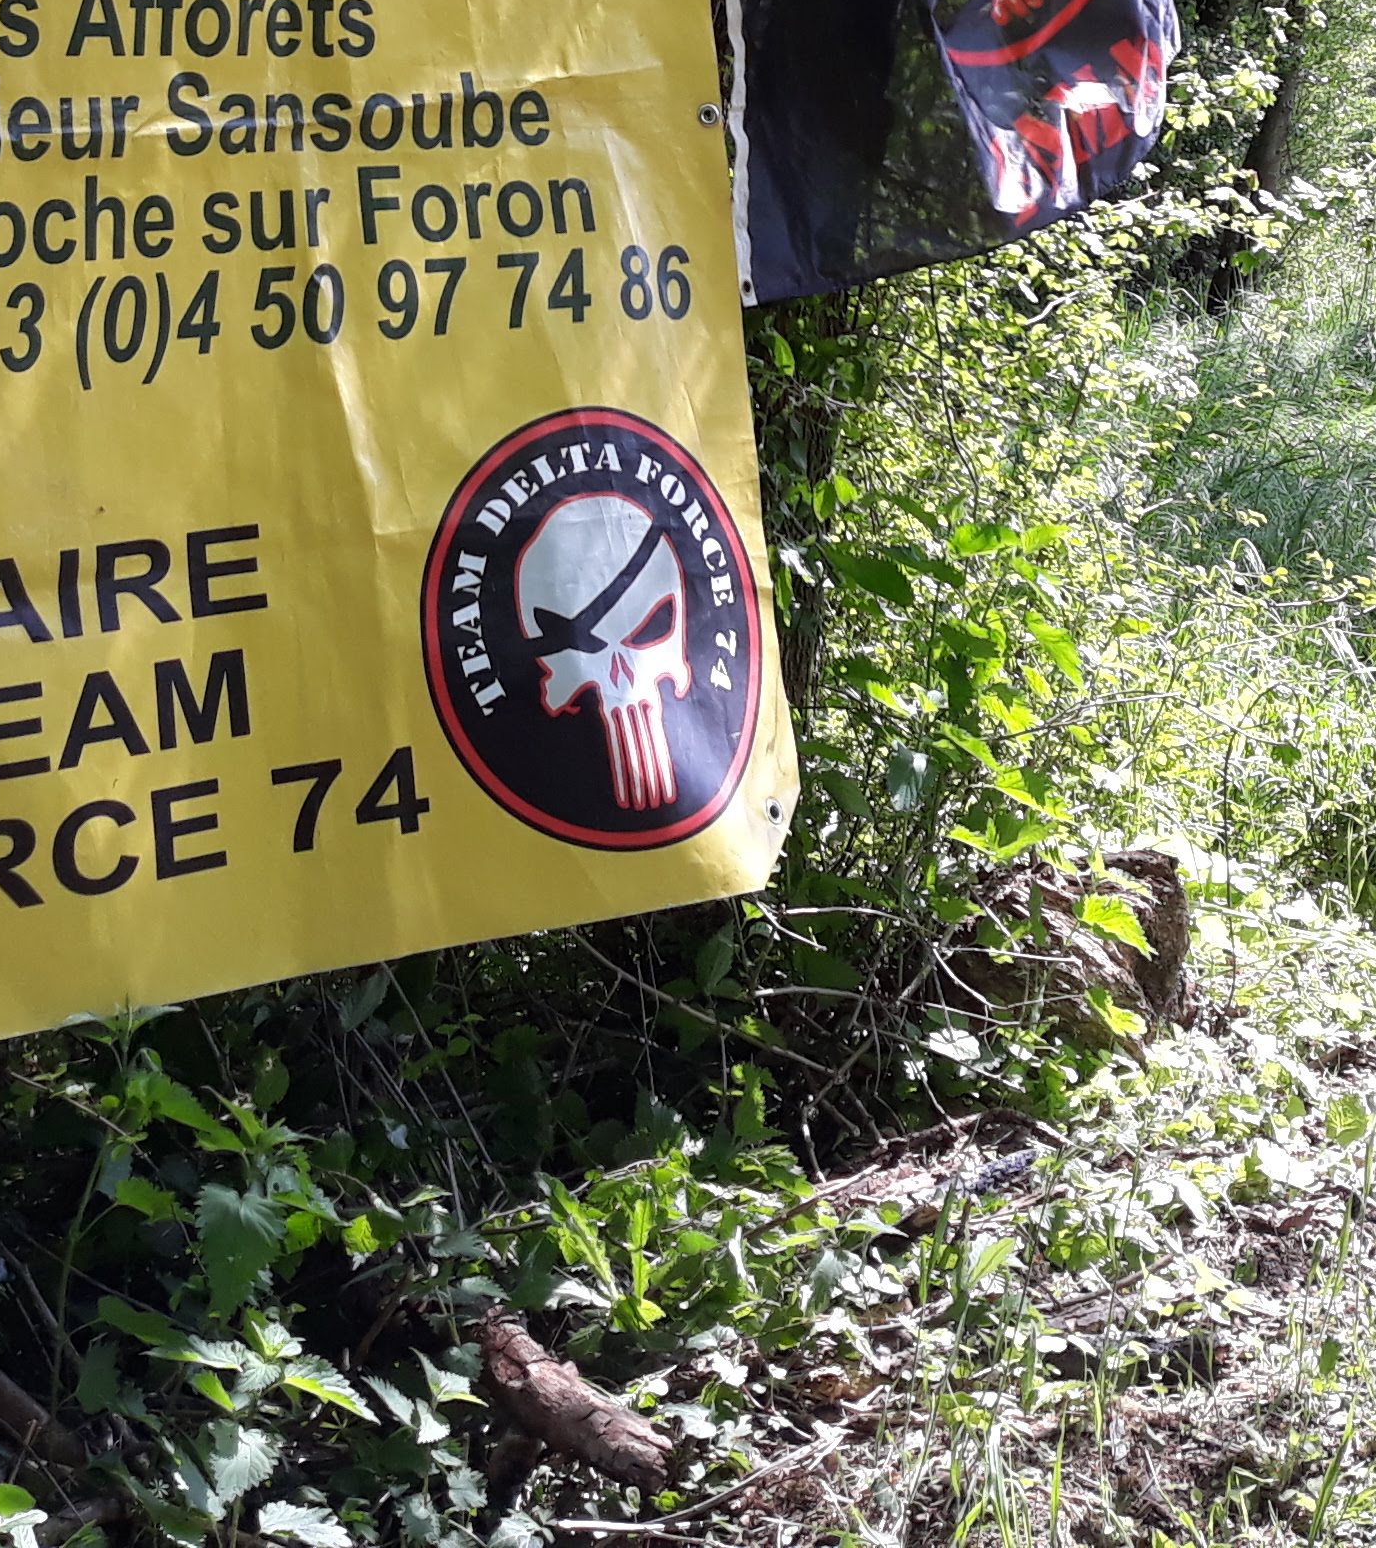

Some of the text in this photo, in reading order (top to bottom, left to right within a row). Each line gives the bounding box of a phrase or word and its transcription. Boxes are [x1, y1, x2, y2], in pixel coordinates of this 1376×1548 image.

[167, 72, 549, 156] Sansoube
[202, 188, 330, 254] sur
[357, 166, 595, 244] Foron
[76, 270, 220, 390] (0)4
[251, 264, 344, 350] 50
[378, 257, 466, 340] 97
[497, 248, 591, 329] 74
[621, 245, 691, 320] 86
[452, 442, 737, 716] TEAM DELTA FORCE 74
[271, 746, 429, 853] 74
